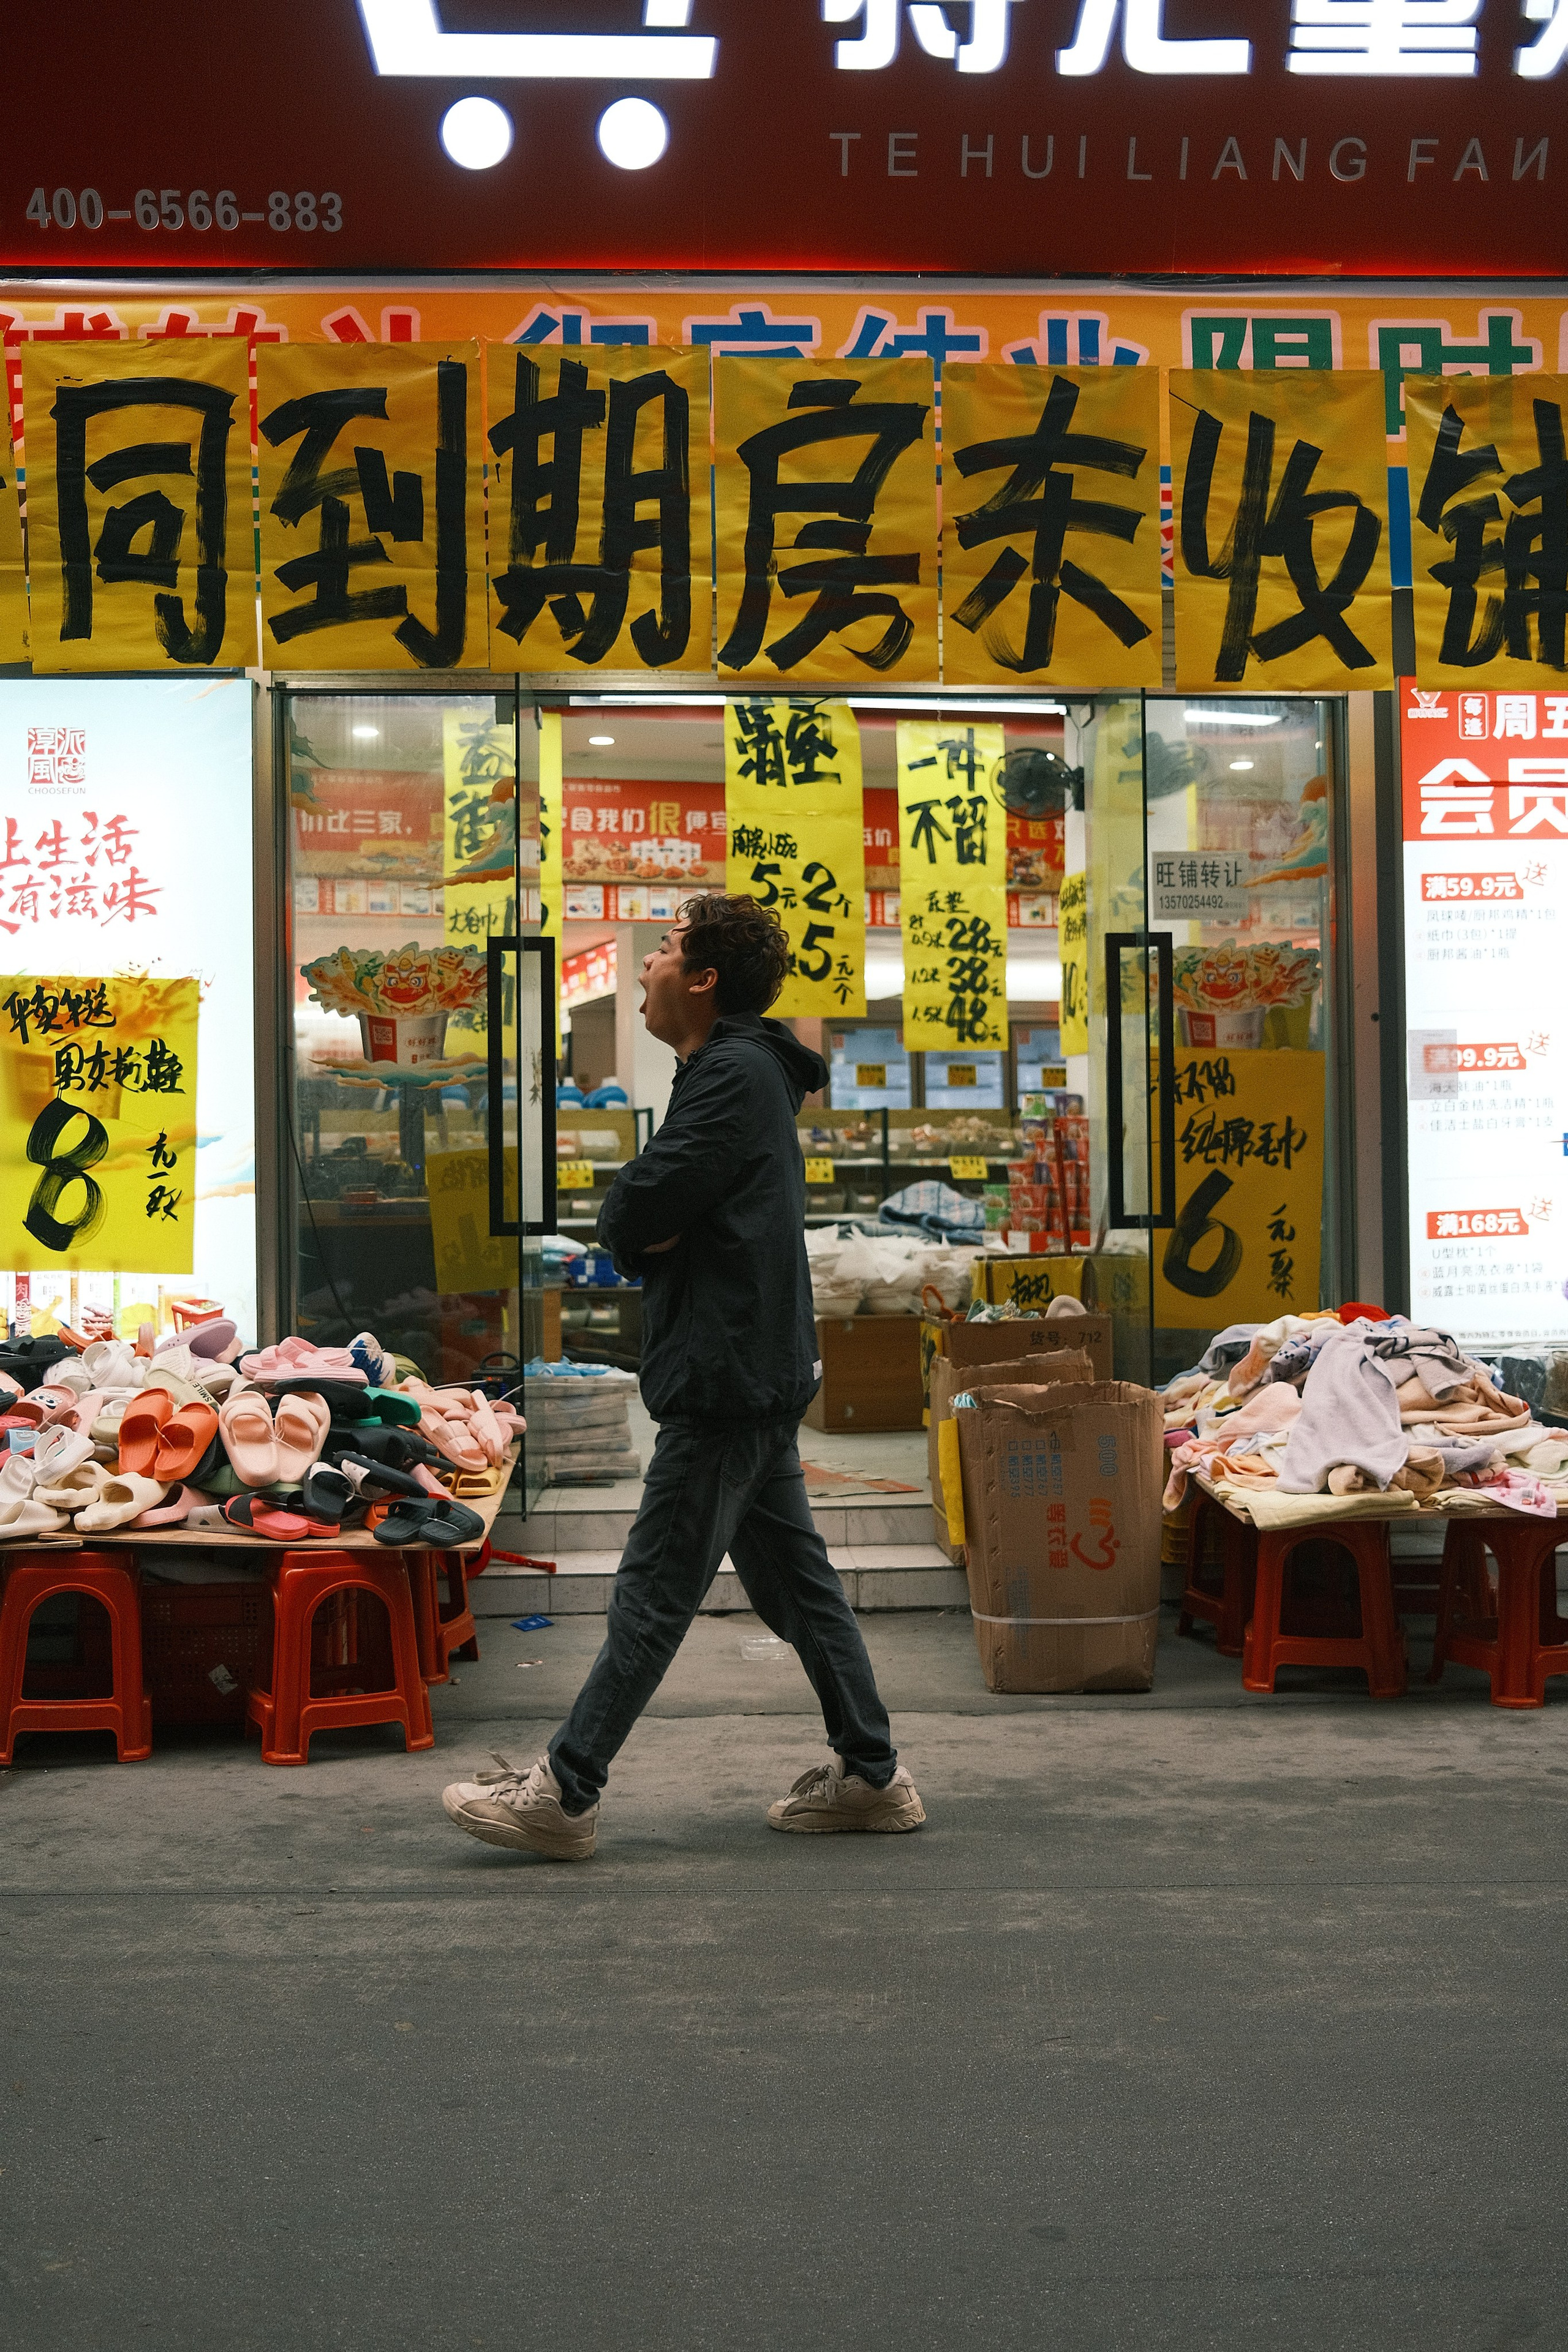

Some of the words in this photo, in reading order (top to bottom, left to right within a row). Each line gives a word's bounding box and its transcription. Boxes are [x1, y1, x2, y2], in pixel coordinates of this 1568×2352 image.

[26, 187, 344, 232] 400-6566-883
[28, 786, 86, 795] CHOOSEFUN
[1419, 758, 1568, 834] 会员
[562, 801, 726, 835] 食我们很便宜
[1156, 860, 1243, 889] 旺铺转让
[1522, 860, 1547, 886] 送
[1425, 875, 1517, 899] 满59.9元
[1159, 895, 1224, 910] 13570254492
[1525, 1030, 1550, 1056] 送
[1427, 1046, 1519, 1068] 99.9元
[23, 1095, 109, 1252] 8
[1528, 1196, 1553, 1221] 送
[1163, 1168, 1243, 1298] 6
[1436, 1212, 1520, 1237] 满168元
[192, 1382, 213, 1403] SMILE
[1097, 1434, 1118, 1477] 500
